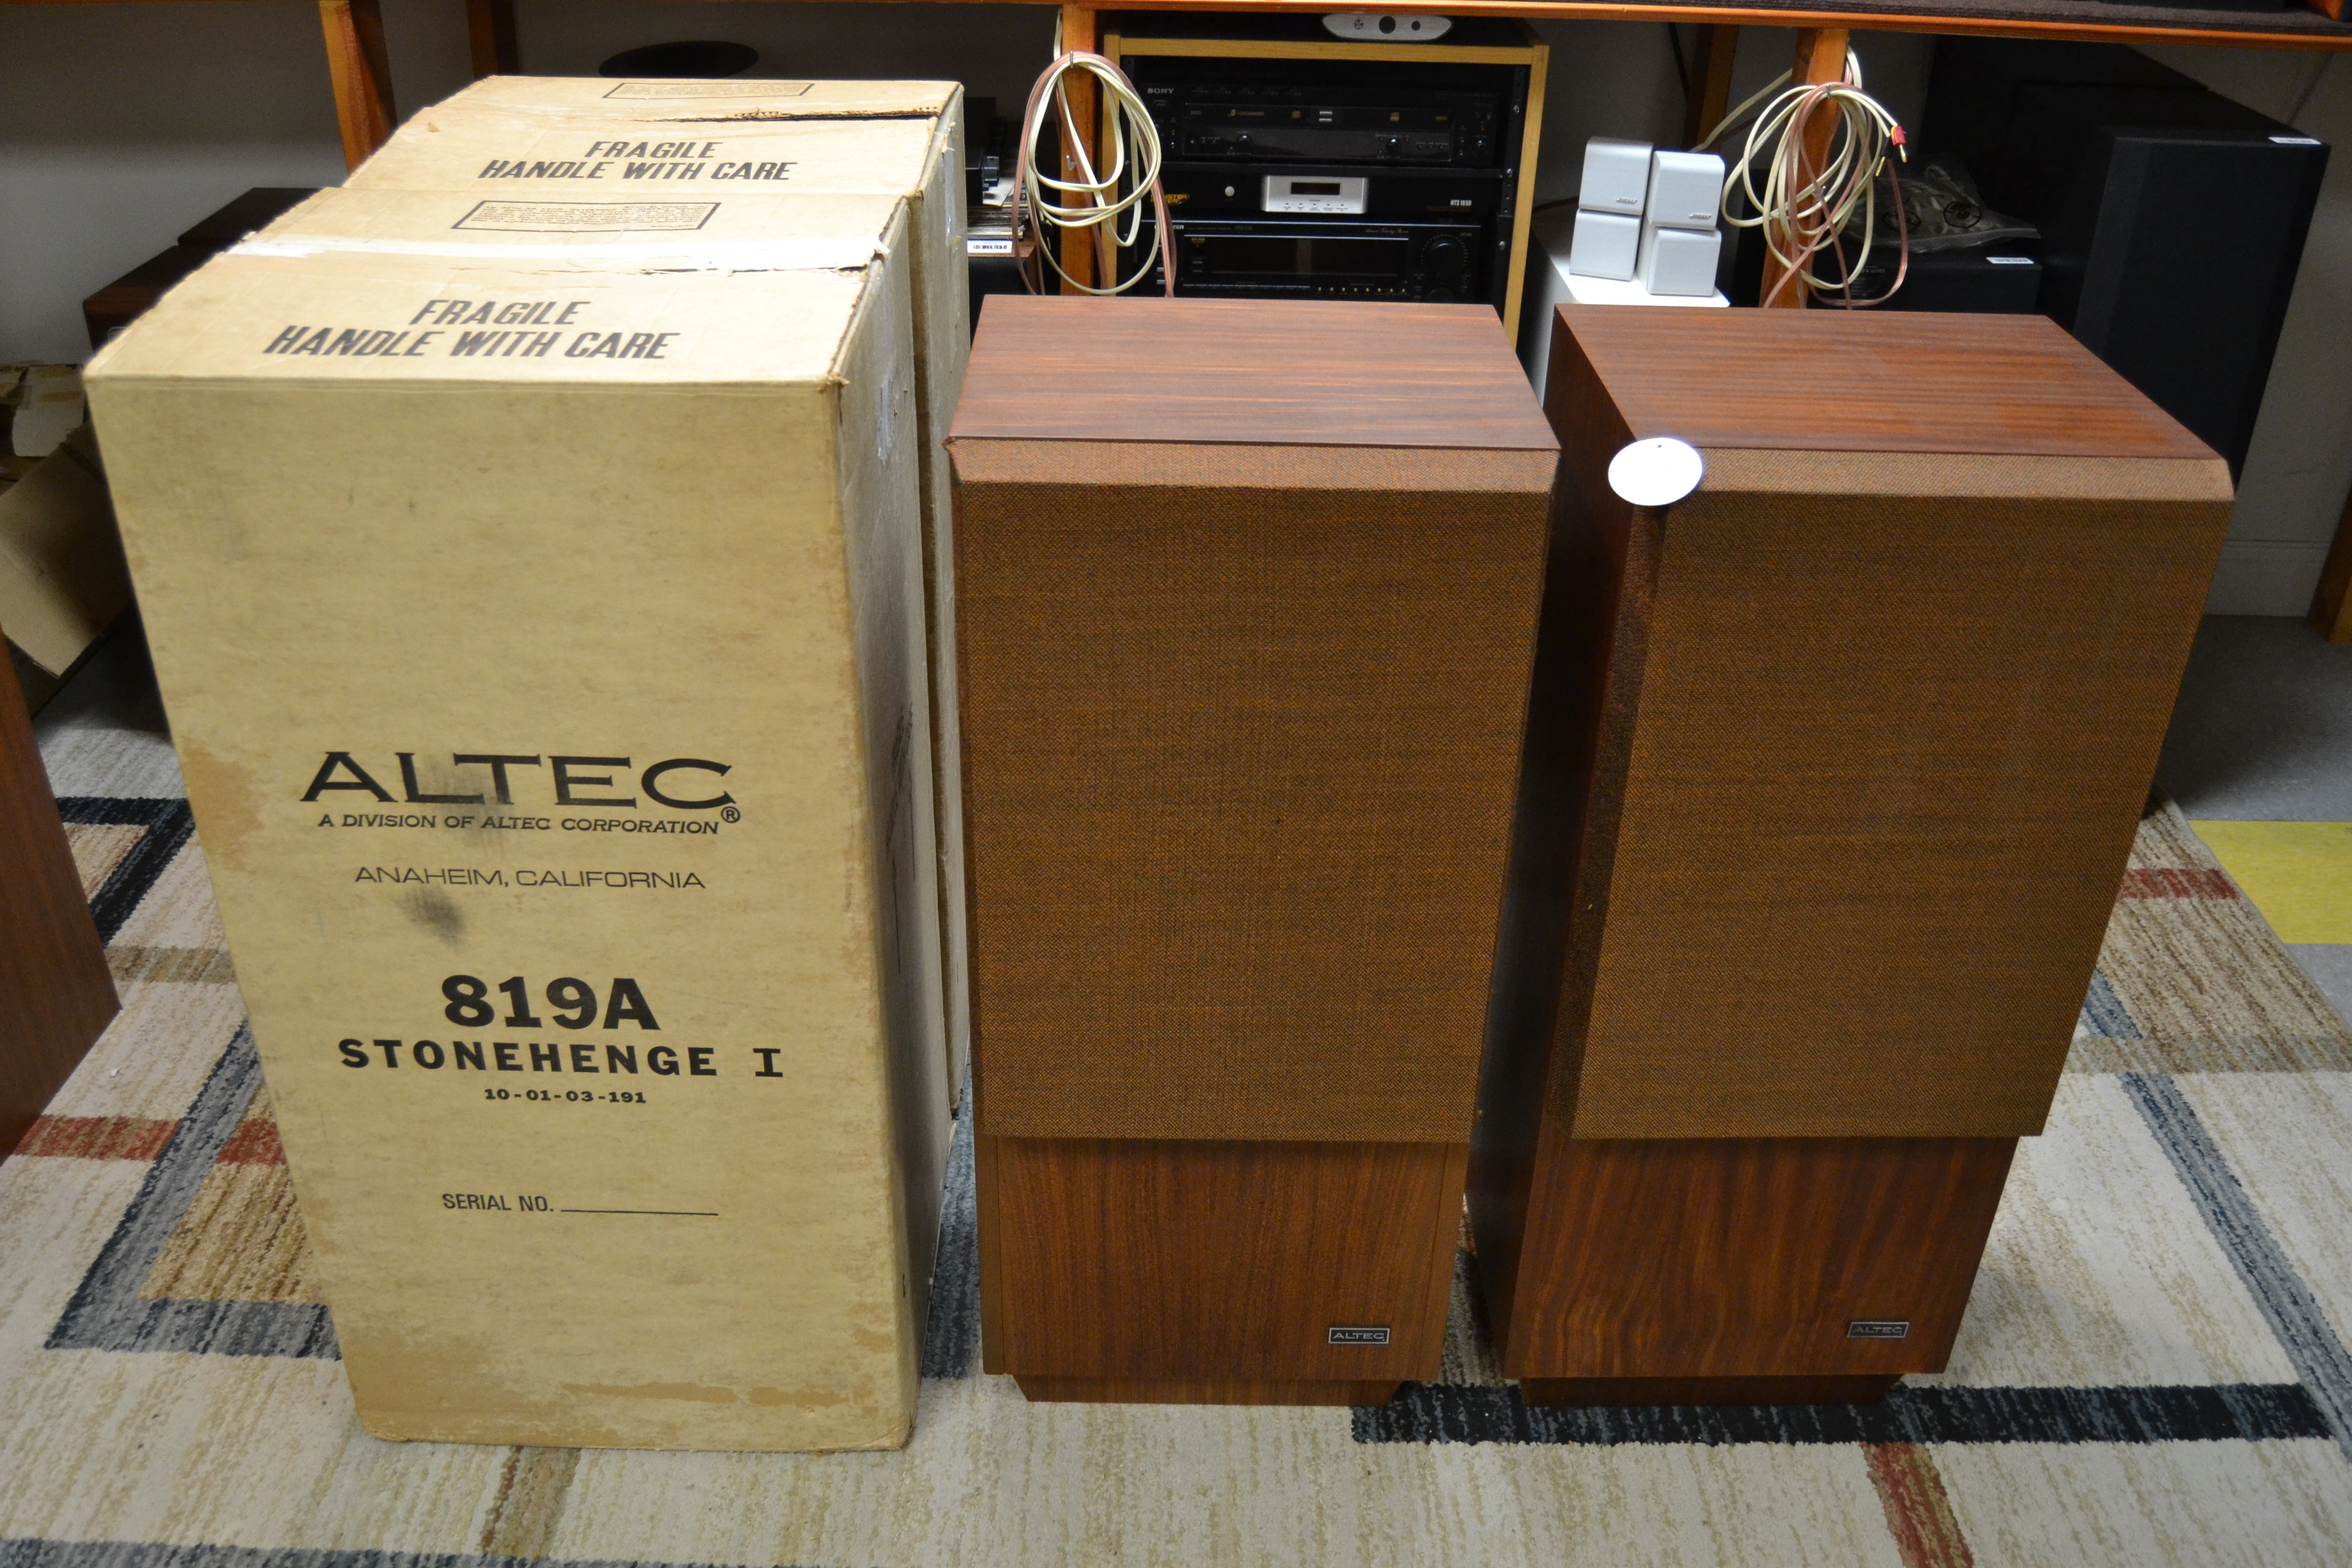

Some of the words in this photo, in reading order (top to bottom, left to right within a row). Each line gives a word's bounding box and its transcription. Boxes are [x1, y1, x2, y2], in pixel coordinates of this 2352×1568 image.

[584, 141, 723, 159] FRAGILE
[478, 161, 615, 180] HANDLE
[623, 162, 708, 181] WITH
[710, 162, 798, 181] CARE
[408, 300, 591, 326] FRAGILE
[262, 326, 445, 357] HANDLE
[449, 331, 562, 358] WITH
[565, 332, 681, 360] CARE
[299, 751, 737, 810] ALTEC
[318, 814, 335, 827] A
[341, 814, 437, 829] DIVISION
[445, 815, 475, 829] OF
[480, 816, 551, 831] ALTEC
[560, 818, 720, 835] CORPORATION
[355, 866, 509, 888] ANAHEIM,
[516, 870, 706, 889] CALIFORNIA
[442, 974, 662, 1031] 819A
[338, 1038, 717, 1076] STONEHENGE
[752, 1048, 784, 1078] I
[484, 1088, 647, 1104] 10-01-03-191
[442, 1192, 512, 1211] SERIAL
[518, 1195, 554, 1212] NO.
